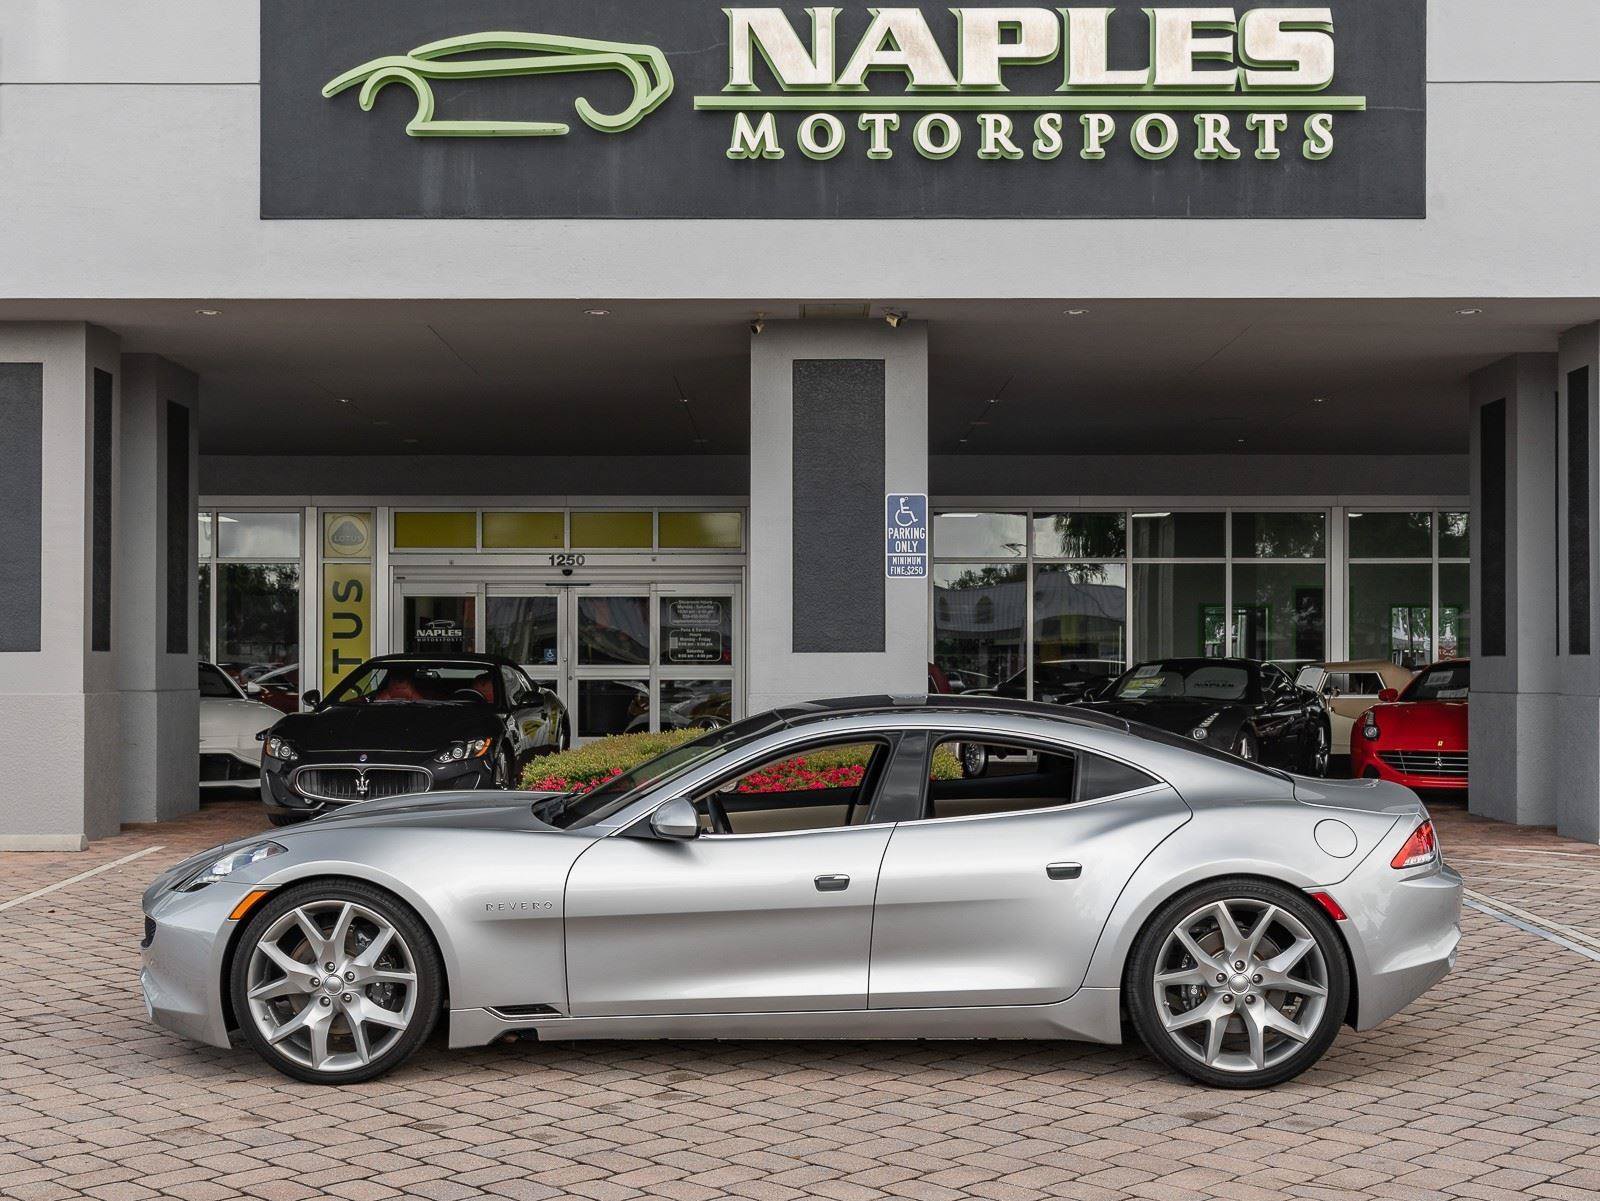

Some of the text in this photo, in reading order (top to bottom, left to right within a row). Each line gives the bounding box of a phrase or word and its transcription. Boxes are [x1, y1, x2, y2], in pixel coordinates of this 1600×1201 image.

[722, 7, 1335, 92] NAPLES
[727, 112, 1335, 160] MOTORSPORTS
[888, 528, 926, 539] PARKING
[895, 541, 918, 552] ONLY
[549, 553, 585, 566] 1250
[892, 557, 921, 565] MINIMUM
[890, 566, 923, 575] FINE $250
[332, 579, 363, 674] TUS
[416, 629, 462, 637] NAPLES
[485, 901, 553, 911] REVERO
